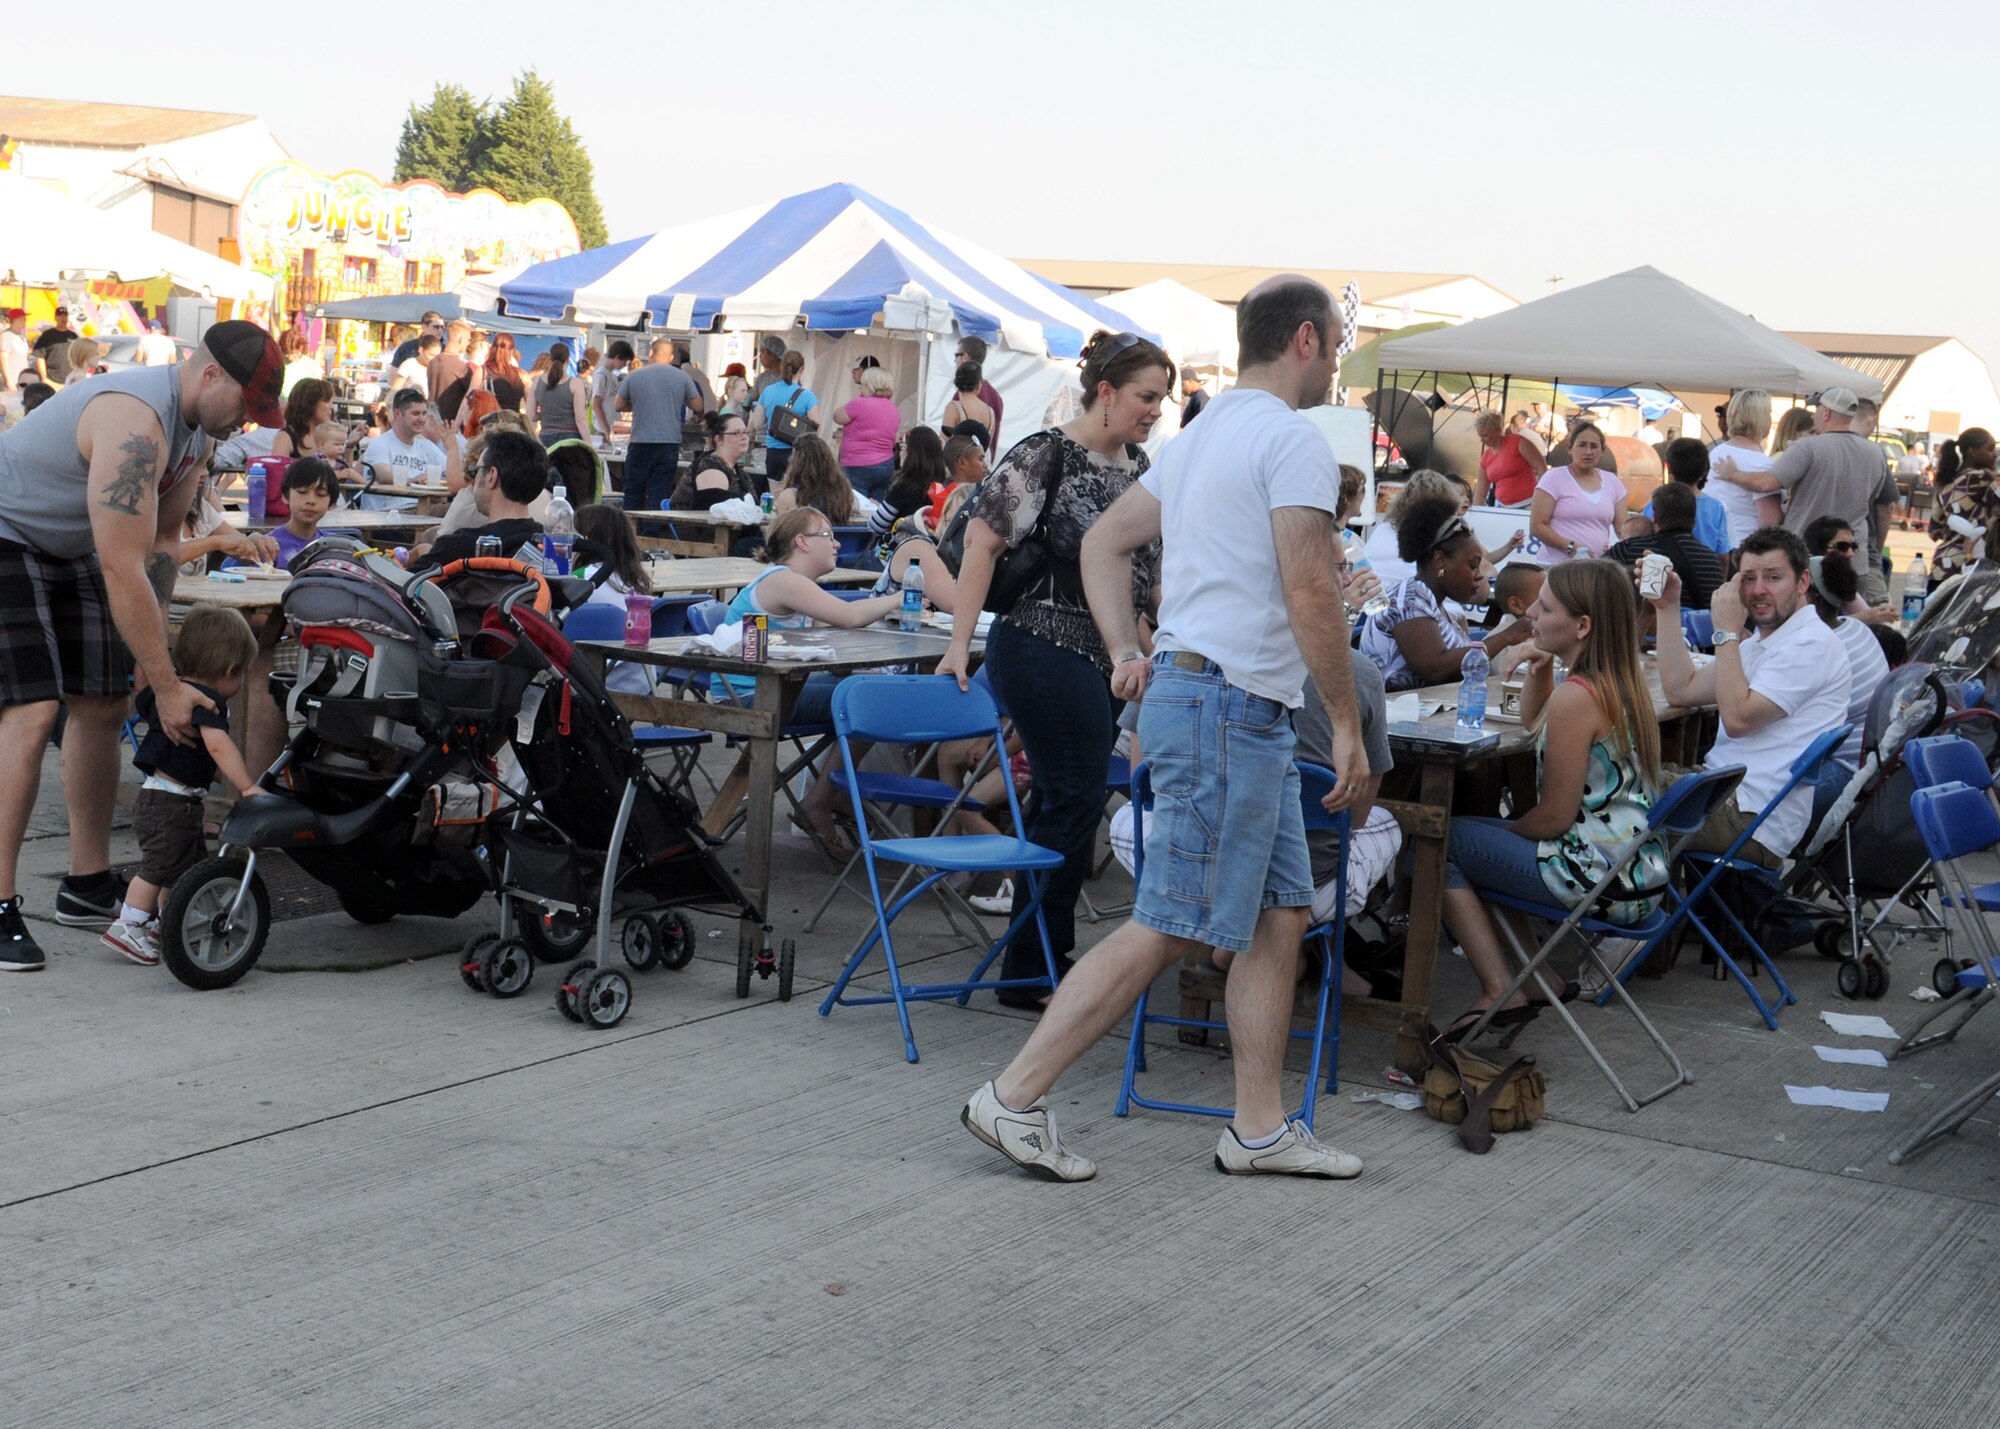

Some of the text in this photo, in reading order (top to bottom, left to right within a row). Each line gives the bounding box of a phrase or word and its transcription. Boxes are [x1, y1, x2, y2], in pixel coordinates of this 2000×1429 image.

[286, 191, 411, 246] JUNGLE
[745, 625, 757, 661] Ribena
[306, 697, 322, 708] Jeep
